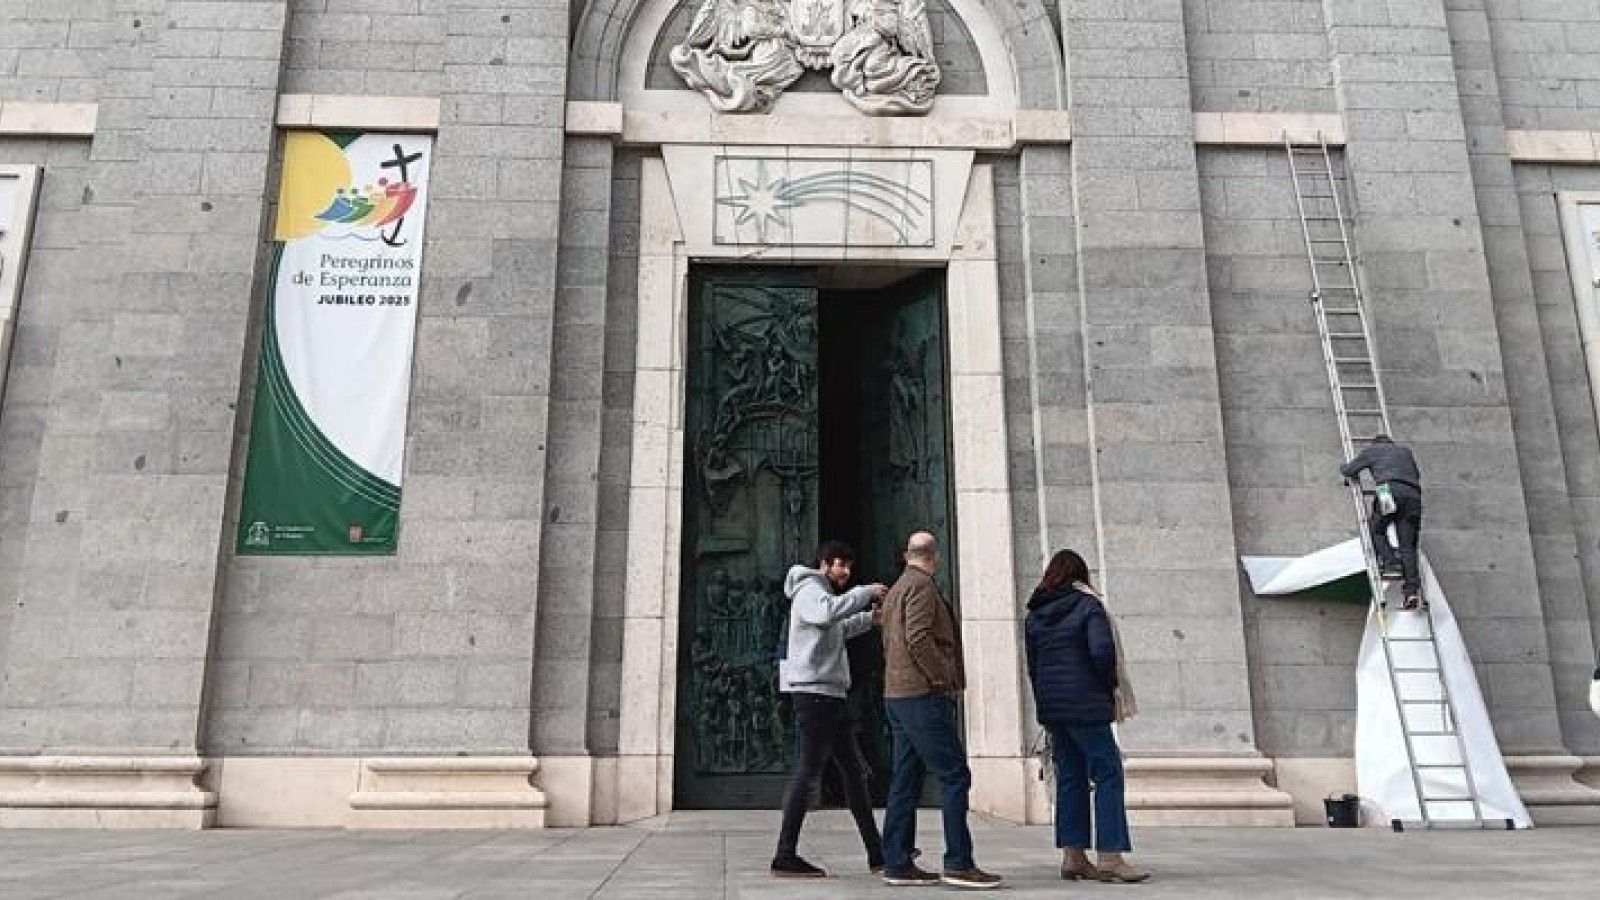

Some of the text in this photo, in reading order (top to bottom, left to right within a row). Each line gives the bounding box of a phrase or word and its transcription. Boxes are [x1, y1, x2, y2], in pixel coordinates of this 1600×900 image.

[320, 253, 414, 273] Peregrinos
[292, 270, 412, 291] de Esperanza
[317, 294, 411, 306] JUBILEO 2025
